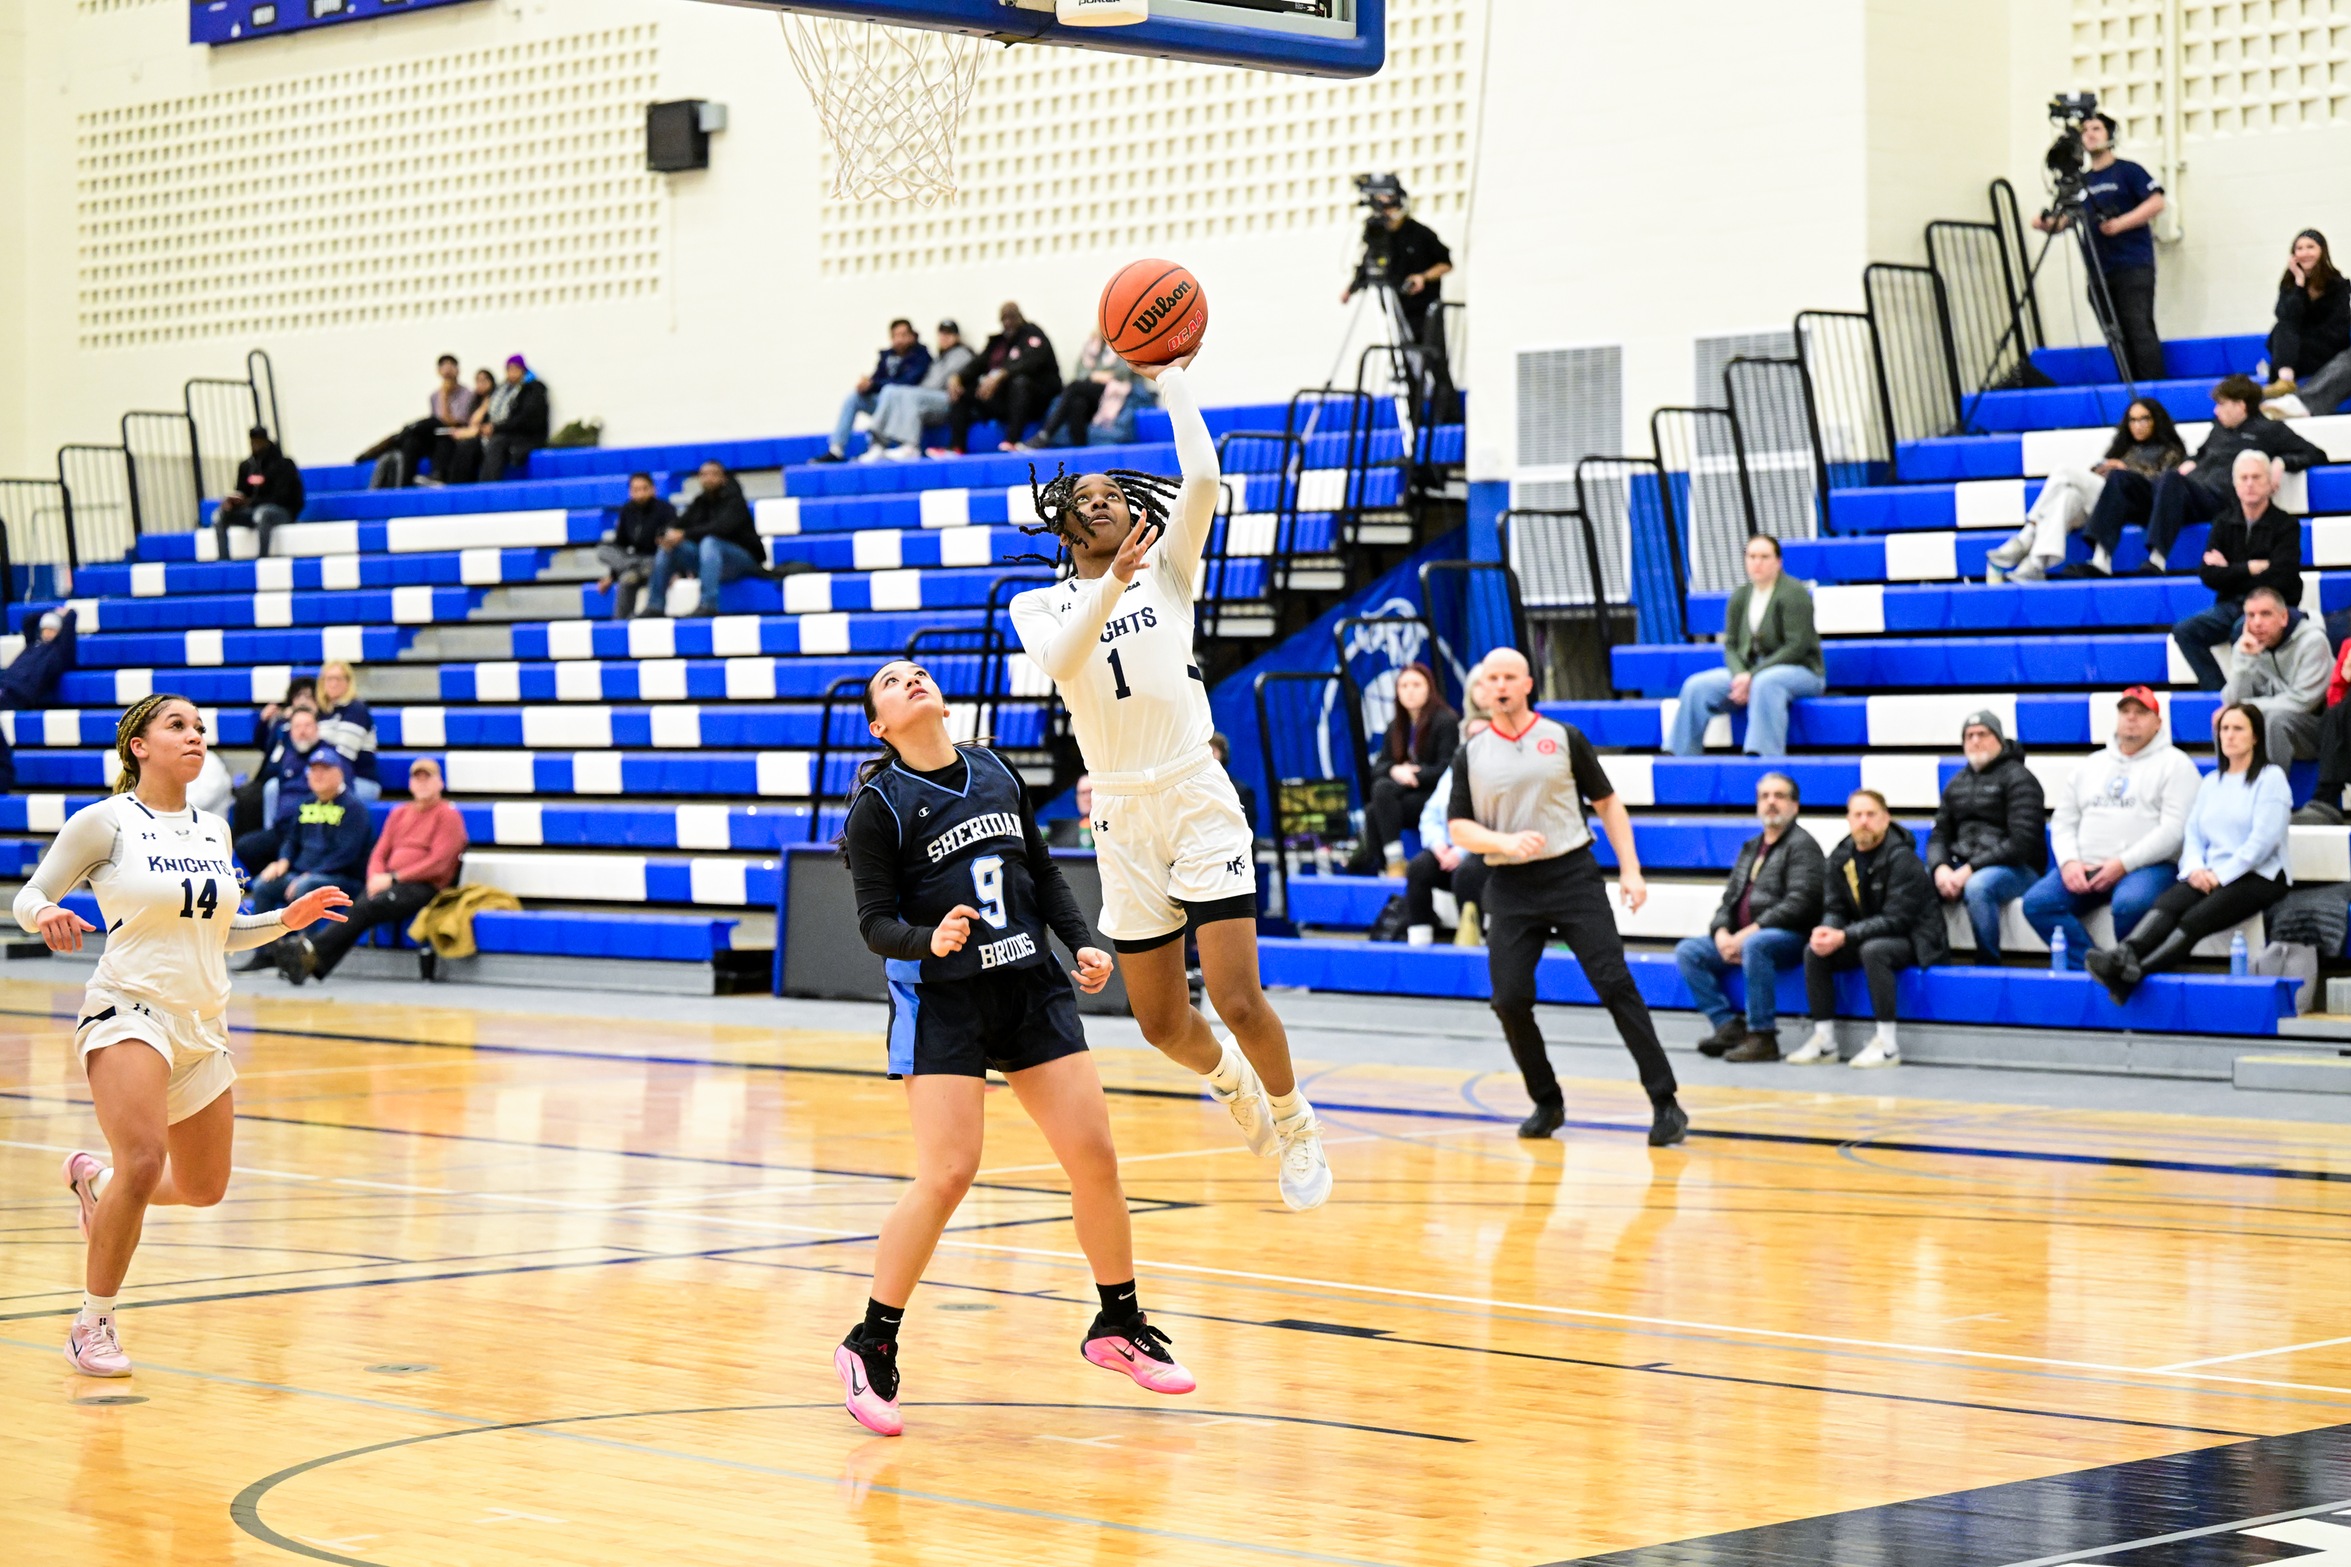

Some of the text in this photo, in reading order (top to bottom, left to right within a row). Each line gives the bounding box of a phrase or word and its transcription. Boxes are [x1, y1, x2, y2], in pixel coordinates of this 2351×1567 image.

[1132, 280, 1192, 334] Wilson
[1168, 310, 1204, 352] OCAA
[1100, 606, 1158, 643] GHTS
[1107, 647, 1132, 700] 1
[926, 812, 1025, 863] SHERIDAN
[147, 855, 231, 876] KNIGHTS
[179, 878, 218, 919] 14
[970, 854, 1007, 930] 9
[978, 932, 1037, 970] BRUINS
